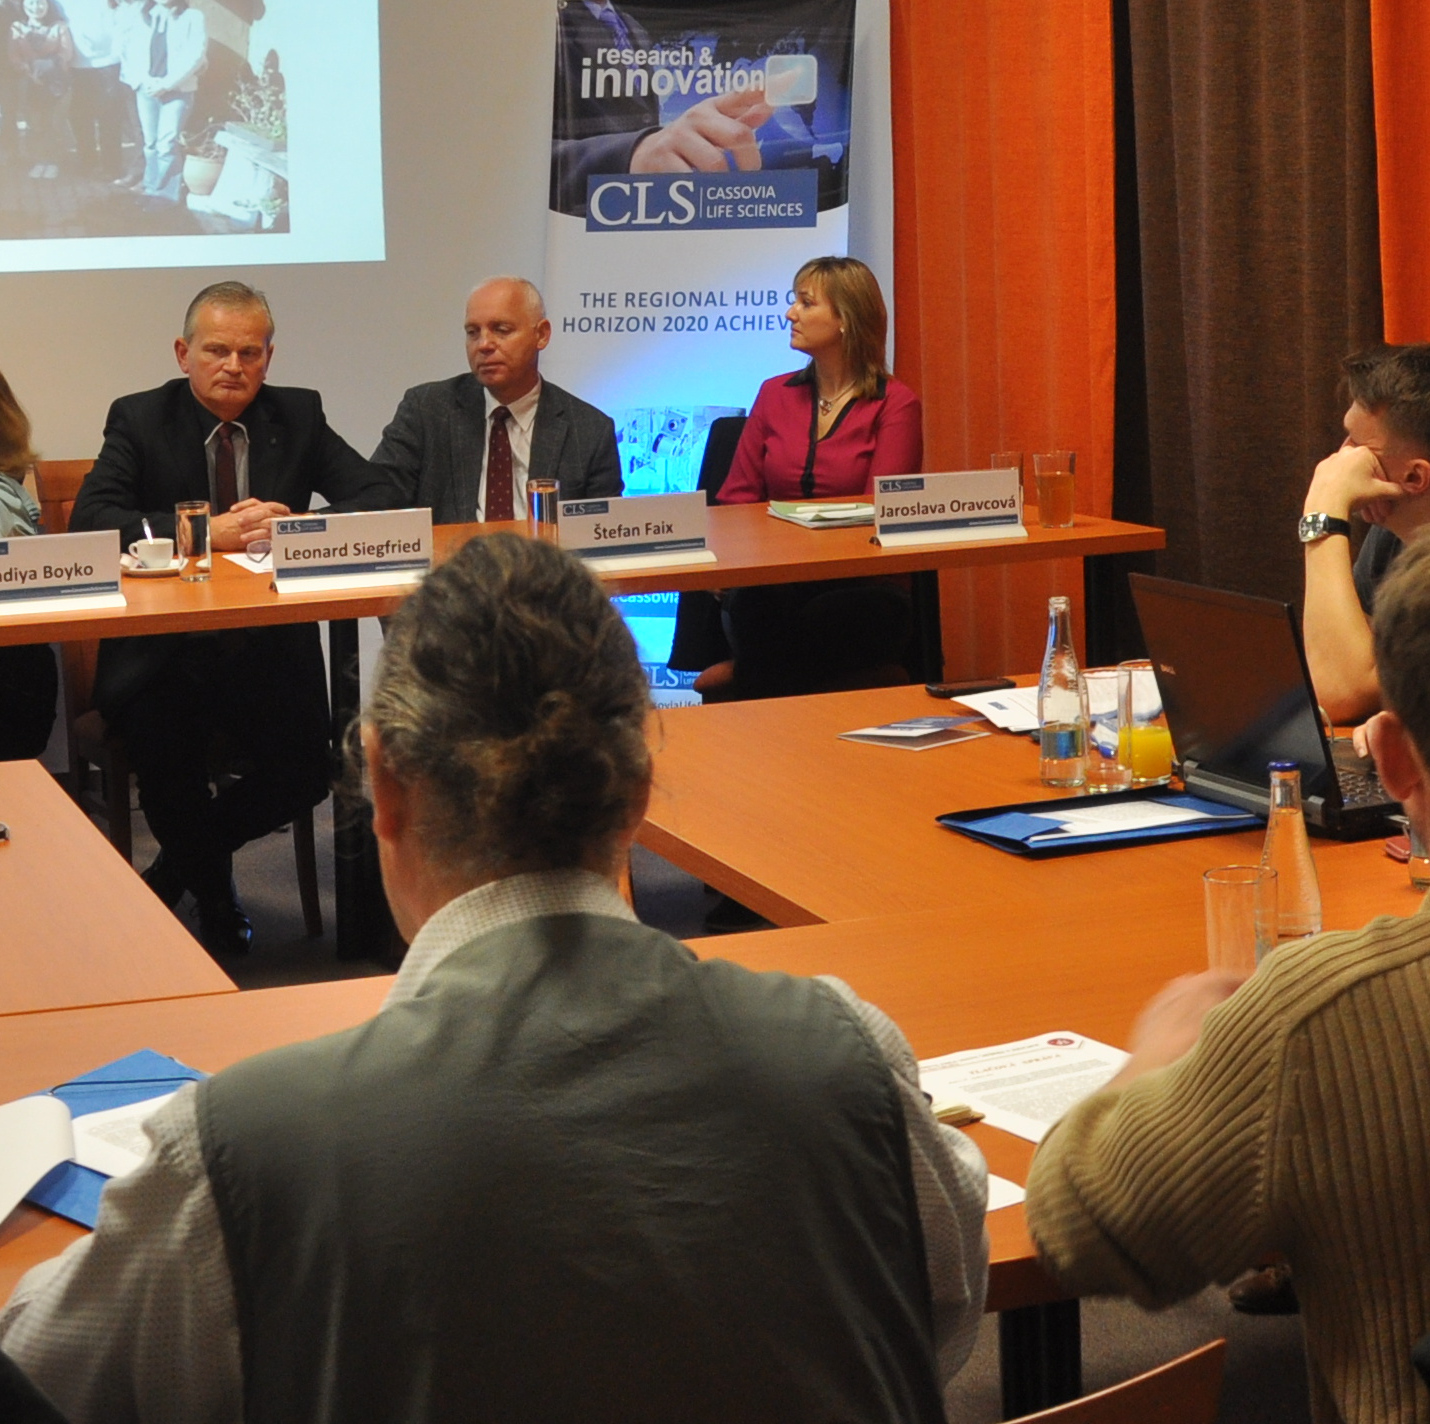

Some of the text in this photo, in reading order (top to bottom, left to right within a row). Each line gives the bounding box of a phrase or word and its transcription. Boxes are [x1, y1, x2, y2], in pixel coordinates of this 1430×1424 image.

[597, 46, 713, 66] research &
[581, 57, 765, 99] innovation
[706, 185, 776, 201] CASSOVIA
[590, 180, 695, 226] CLS
[706, 202, 804, 219] LIFE SCIENCES
[580, 292, 617, 308] THE
[624, 290, 729, 308] REGIONAL
[735, 290, 778, 307] HUB
[562, 314, 790, 333] HORIZON 2020 ACHIEV
[879, 495, 1016, 518] Jaroslava Oravcová
[594, 521, 674, 540] Štefan Faix
[284, 538, 421, 561] Leonard Siegfried
[43, 562, 94, 581] Boyko
[642, 665, 679, 687] LS
